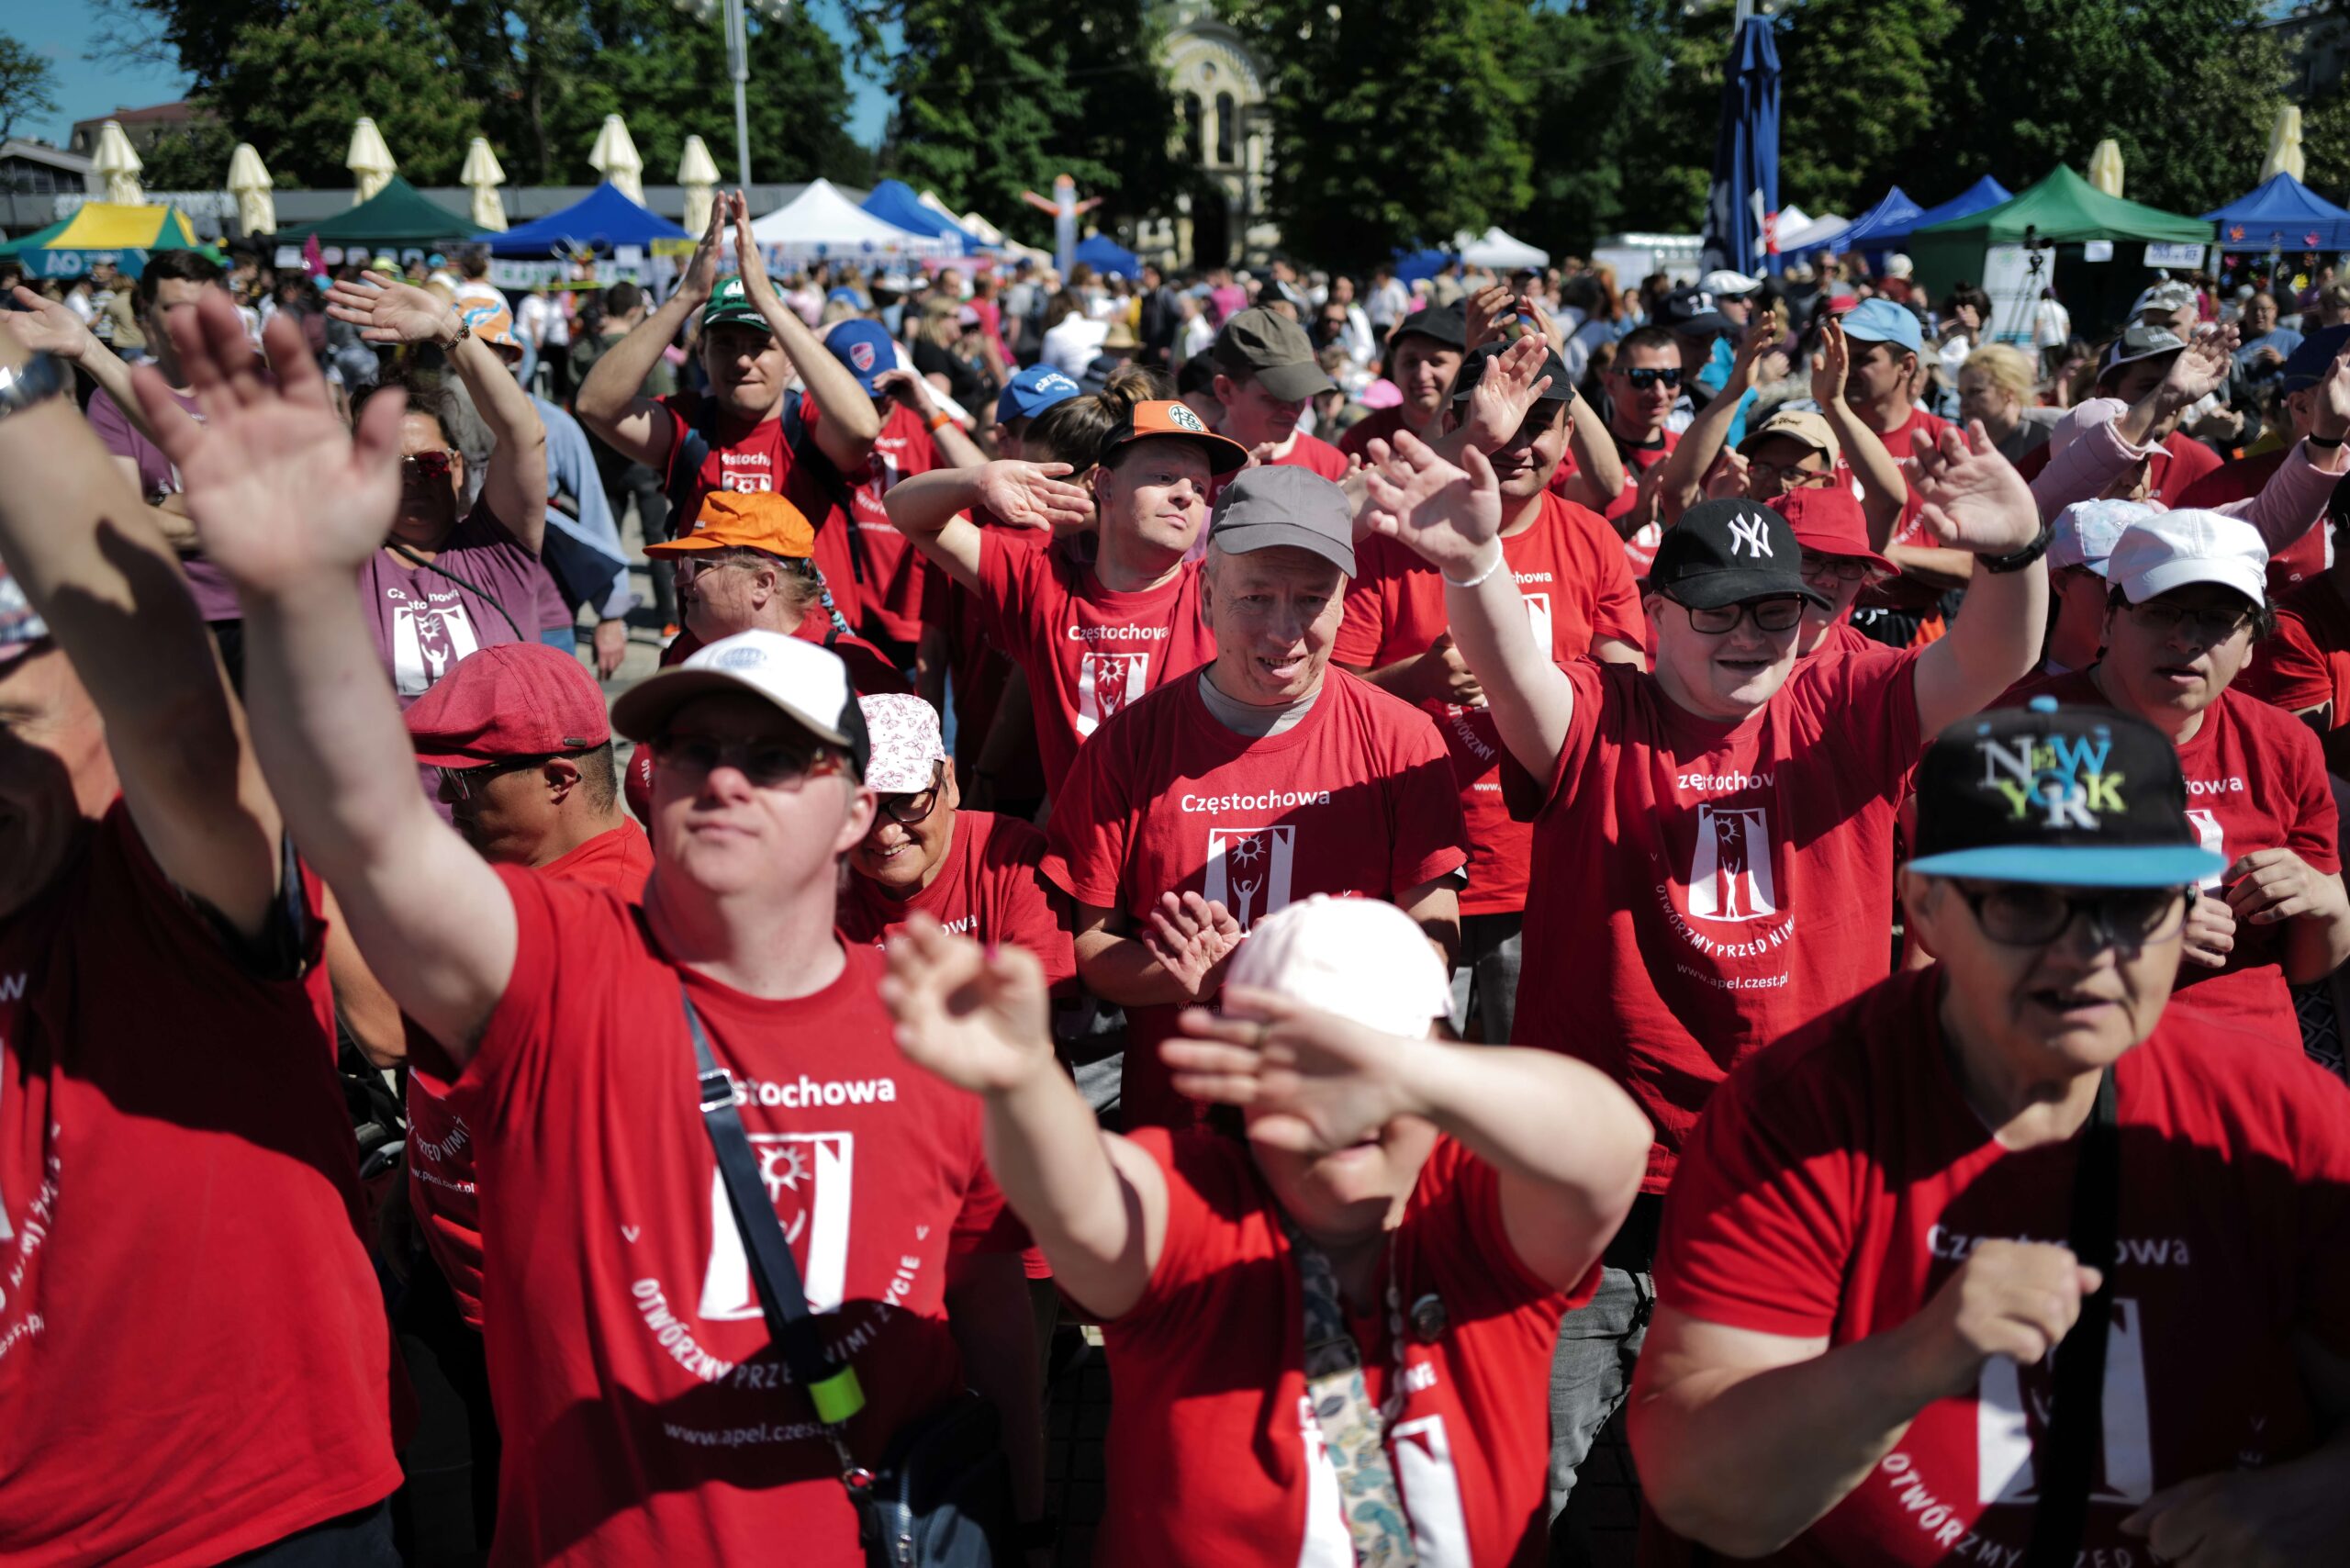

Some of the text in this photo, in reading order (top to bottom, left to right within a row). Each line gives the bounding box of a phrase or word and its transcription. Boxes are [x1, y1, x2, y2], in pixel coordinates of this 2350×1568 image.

[1727, 512, 1774, 558] NY
[1513, 570, 1553, 584] howa
[1975, 733, 2112, 790] NEW
[1181, 790, 1331, 815] Częstochowa
[1998, 768, 2127, 832] YORK
[1655, 884, 1715, 954] OTWÓRZMY
[1716, 938, 1766, 958] PRZED
[1676, 962, 1788, 990] www.apel.czest.pl
[733, 1075, 897, 1108] stochowa
[733, 1361, 793, 1390] PRZE
